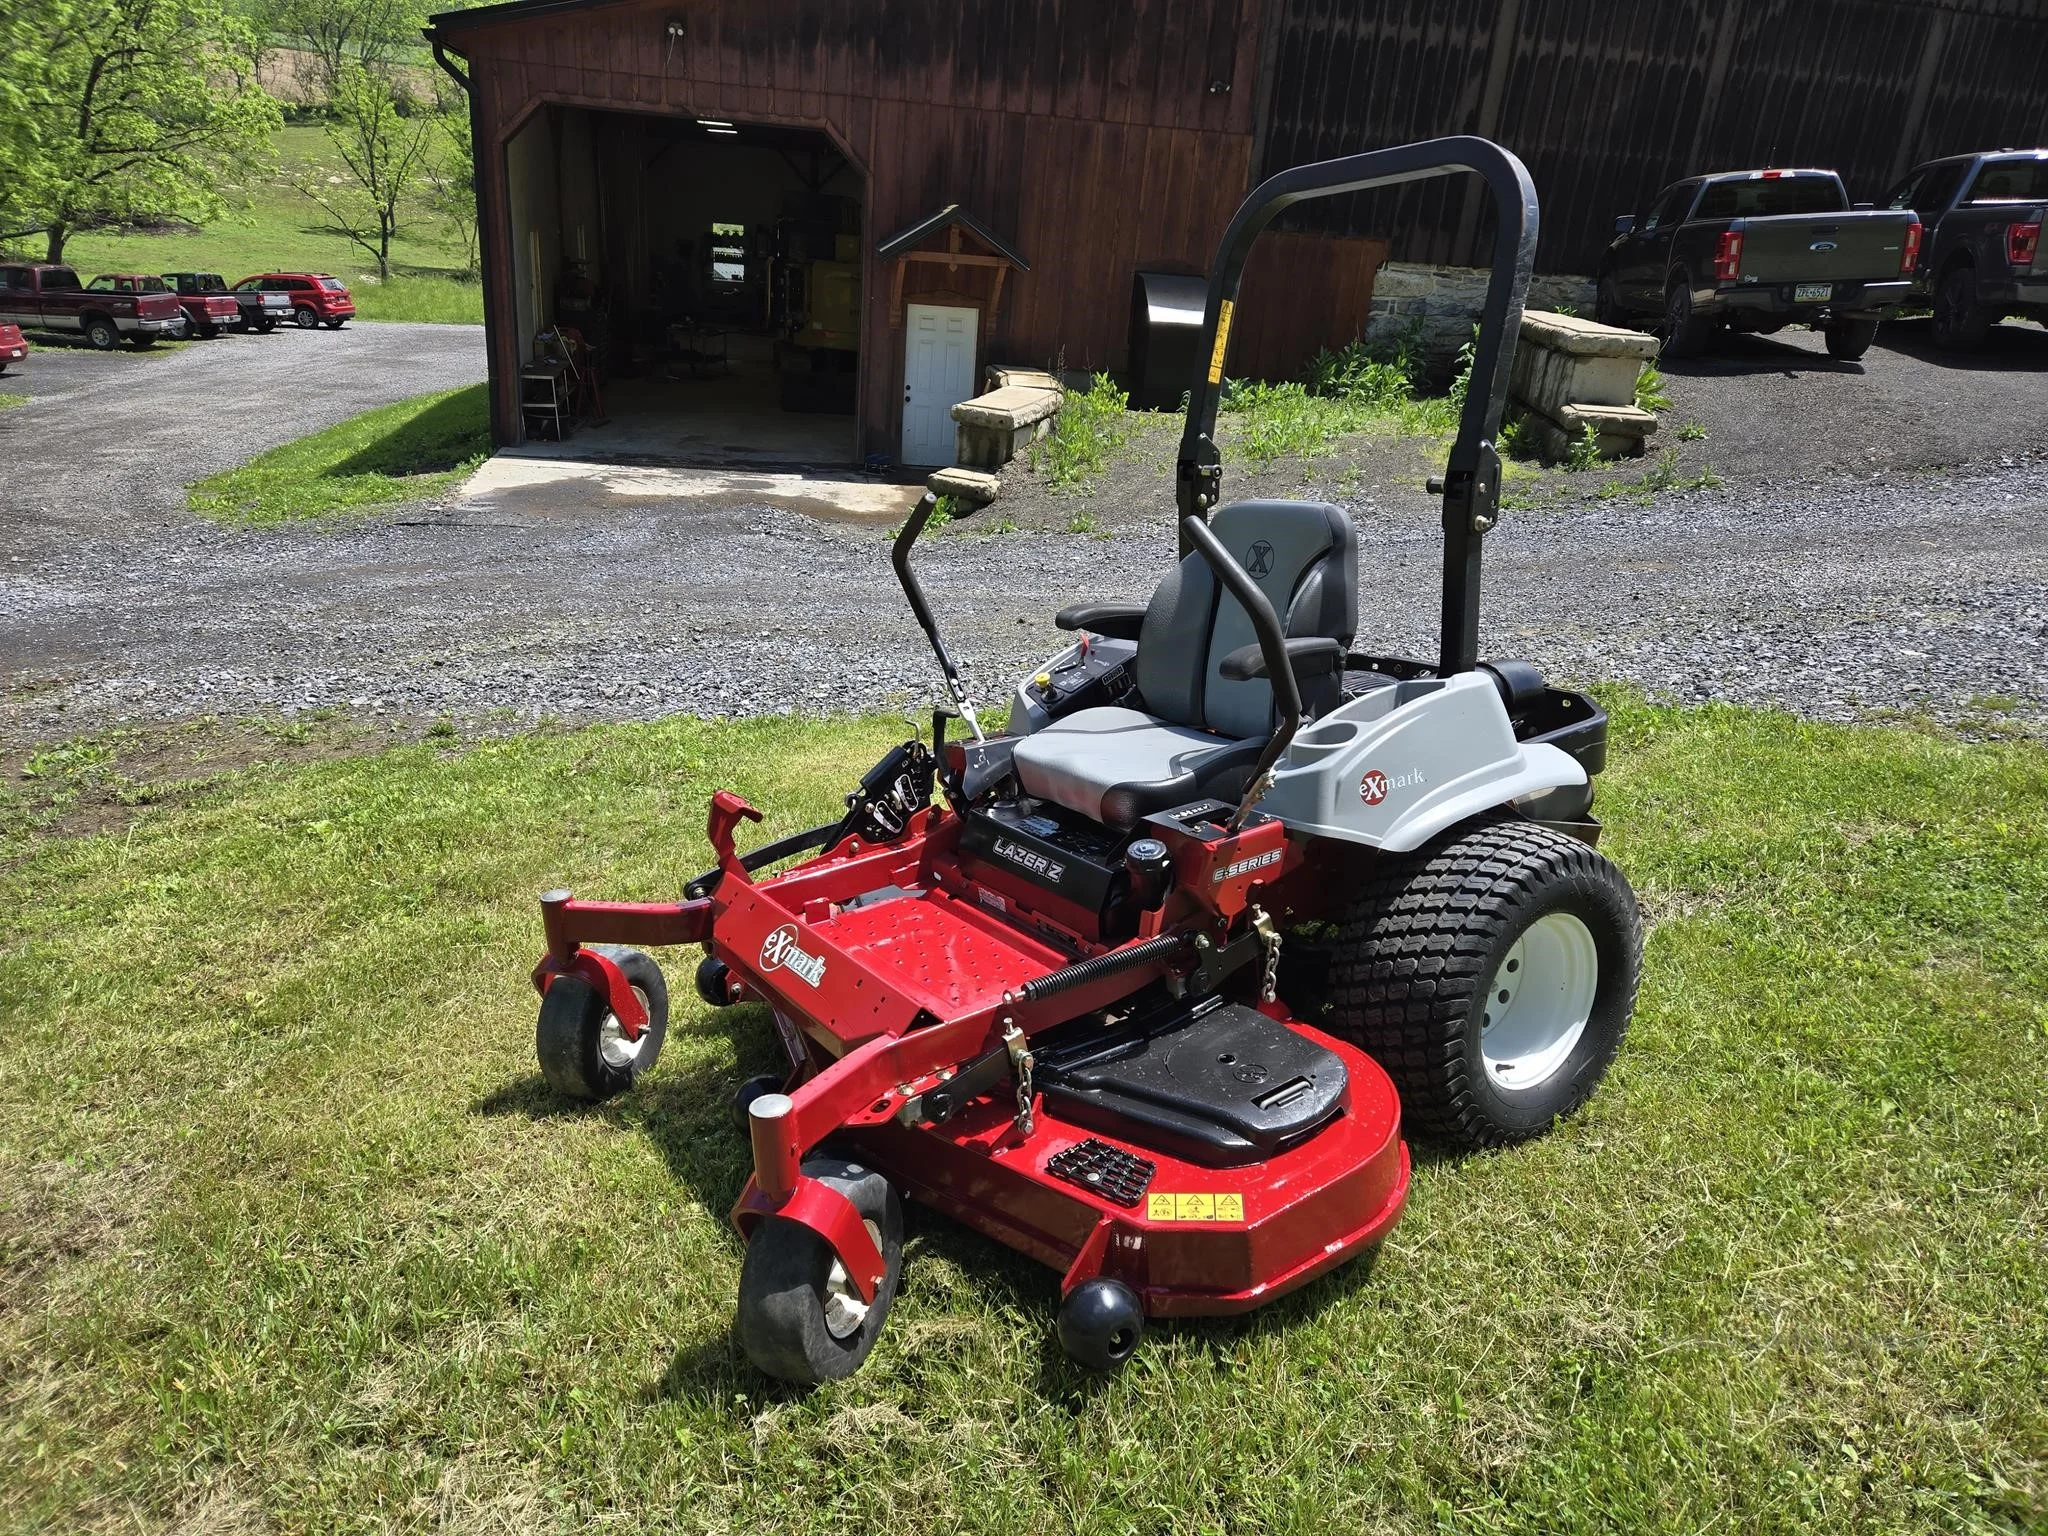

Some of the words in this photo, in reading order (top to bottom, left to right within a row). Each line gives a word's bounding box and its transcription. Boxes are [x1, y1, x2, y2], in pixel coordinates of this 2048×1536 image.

[1248, 543, 1272, 576] X
[994, 837, 1047, 875] LAZER
[1046, 861, 1065, 882] Z
[1213, 848, 1282, 882] E-SERIES
